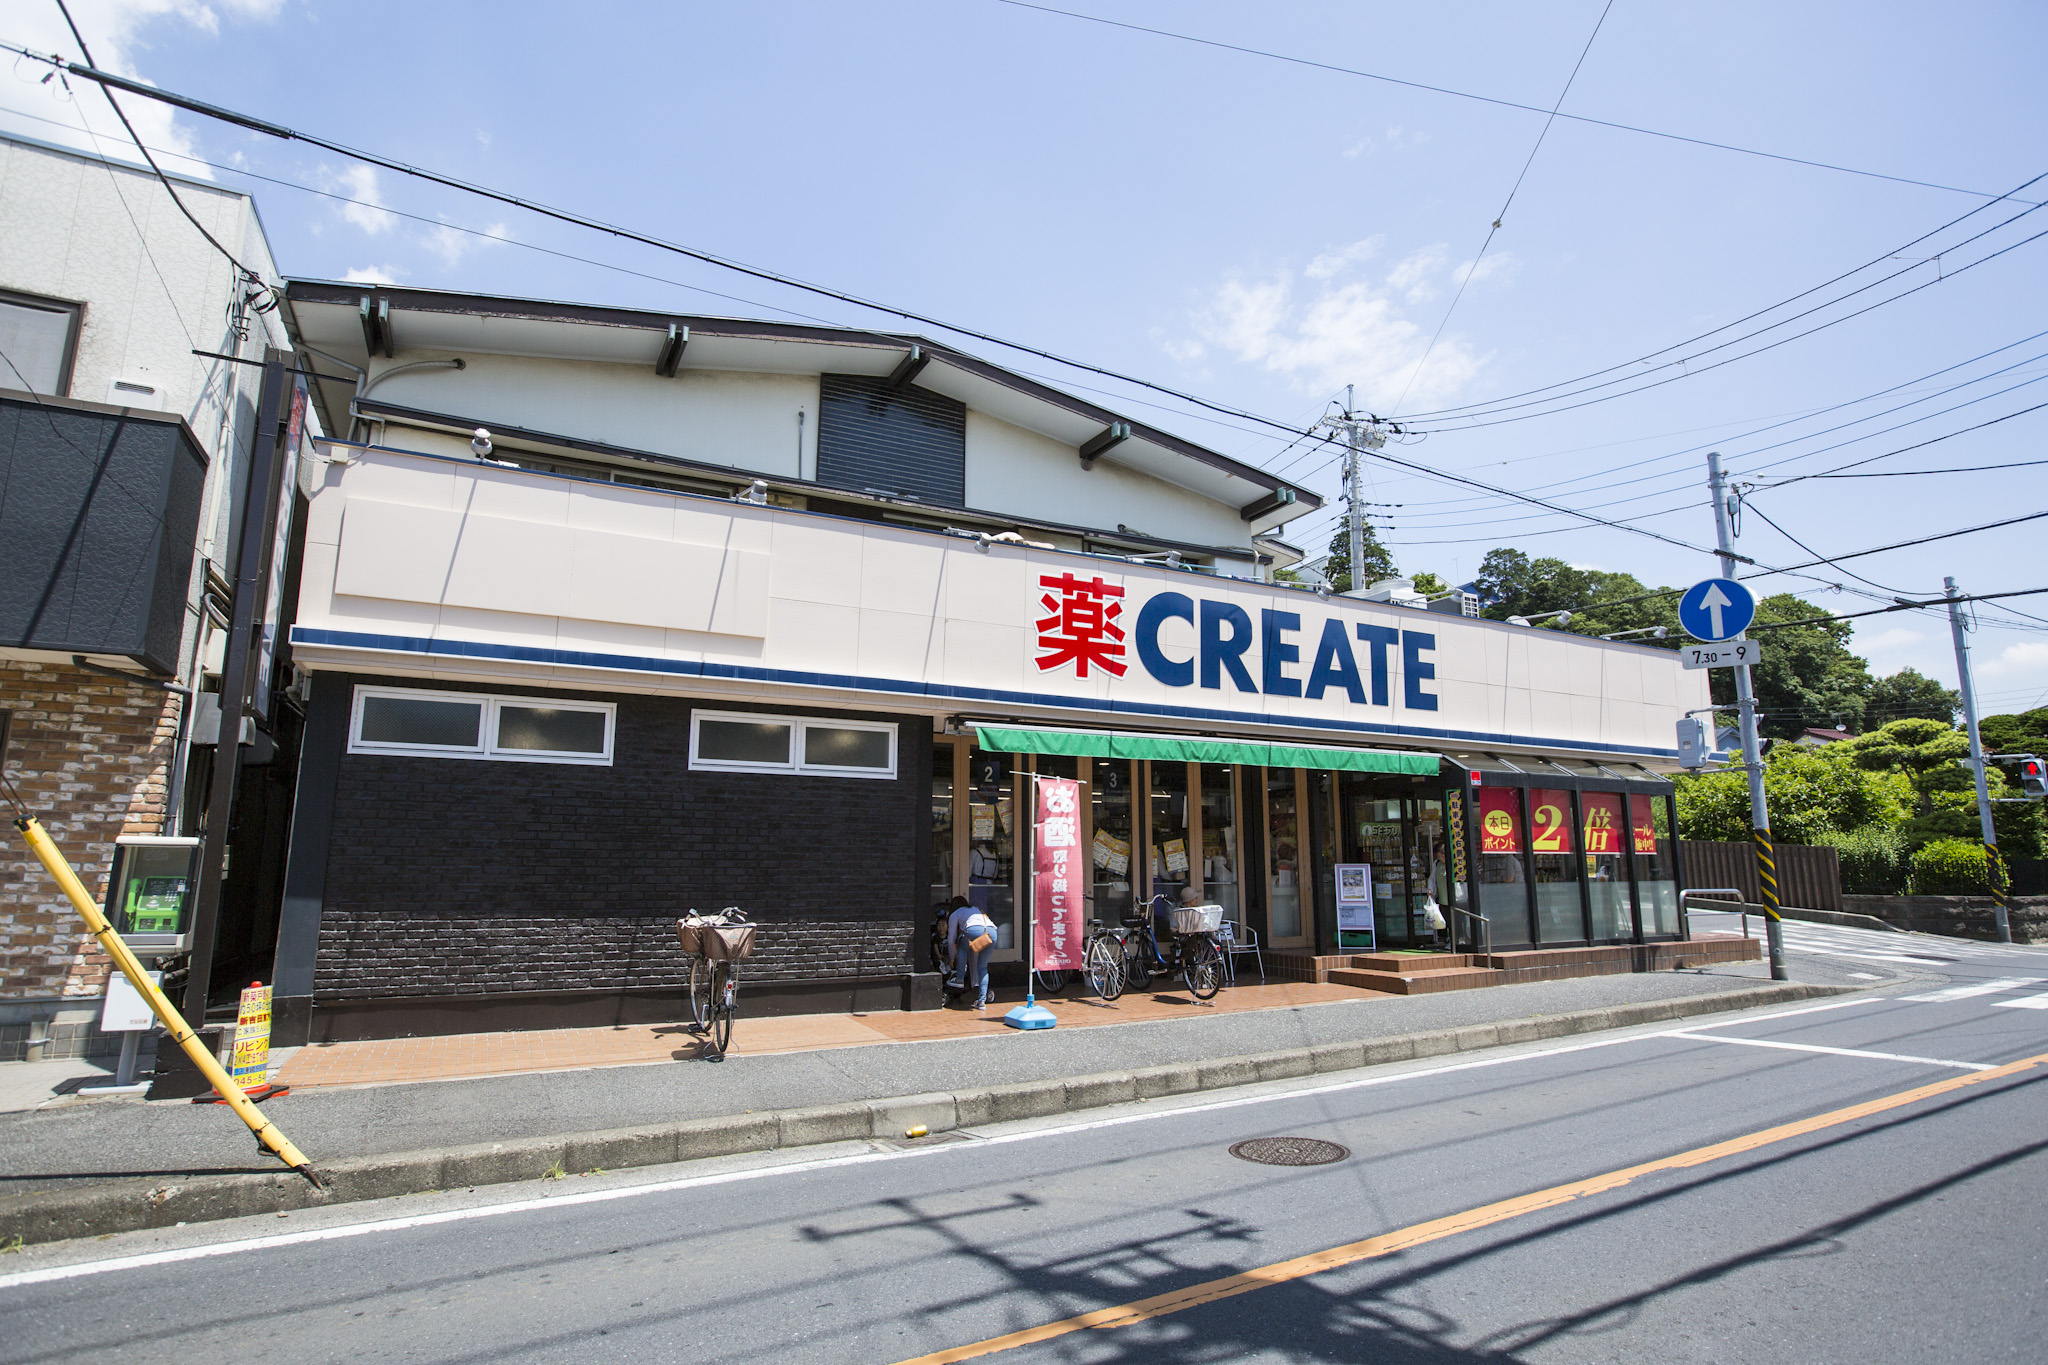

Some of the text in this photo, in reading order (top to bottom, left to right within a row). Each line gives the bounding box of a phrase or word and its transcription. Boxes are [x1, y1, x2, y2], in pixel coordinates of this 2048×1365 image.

[259, 449, 296, 688] CREATE
[1034, 572, 1439, 712] 薬 CREATE
[1692, 650, 1718, 665] 7.30
[1736, 646, 1747, 660] 9
[984, 765, 993, 783] 2
[1109, 772, 1117, 788] 3
[1488, 815, 1510, 831] 本日
[1633, 824, 1652, 837] ール
[1484, 837, 1516, 850] ポイント
